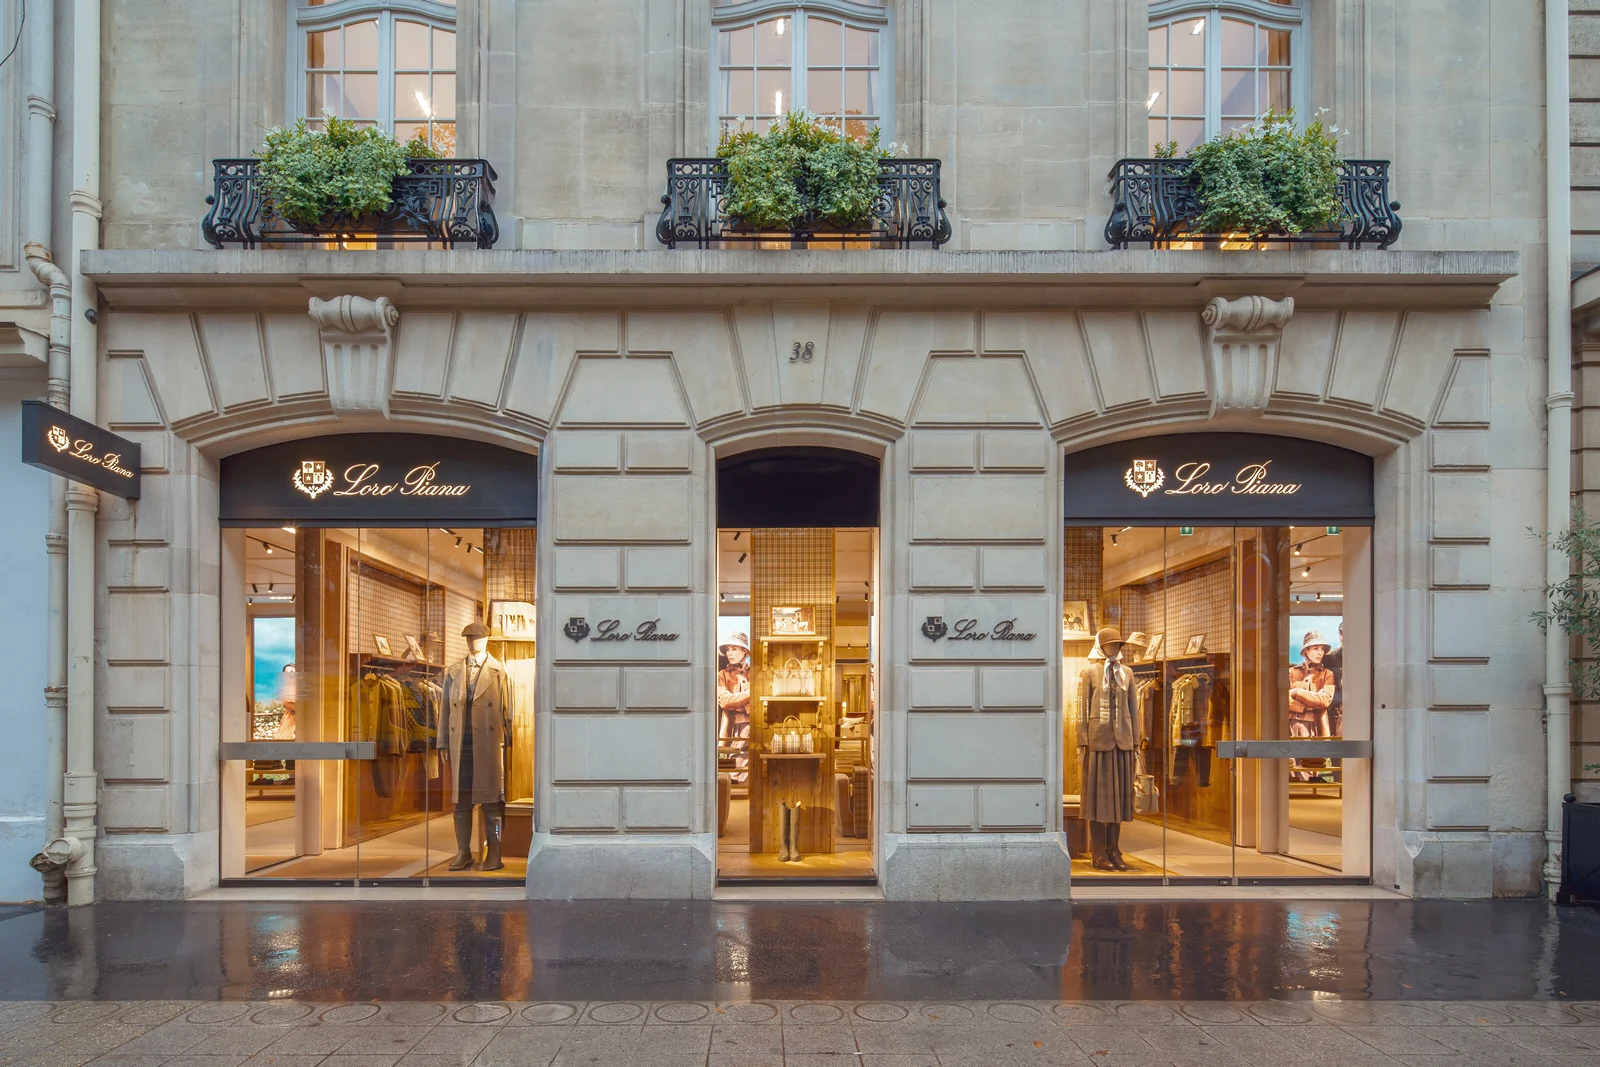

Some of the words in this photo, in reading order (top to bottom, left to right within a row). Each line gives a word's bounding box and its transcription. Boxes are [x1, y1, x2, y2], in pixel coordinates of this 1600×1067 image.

[789, 341, 815, 361] 38
[68, 439, 101, 465] Loro
[101, 452, 135, 479] Piana
[333, 463, 399, 496] Loro
[400, 461, 471, 496] Piana
[1164, 462, 1230, 495] Loro
[1231, 459, 1302, 495] Piana
[590, 619, 633, 641] Loro
[633, 617, 680, 642] Piana
[947, 618, 990, 641] Loro
[990, 617, 1037, 641] Piana
